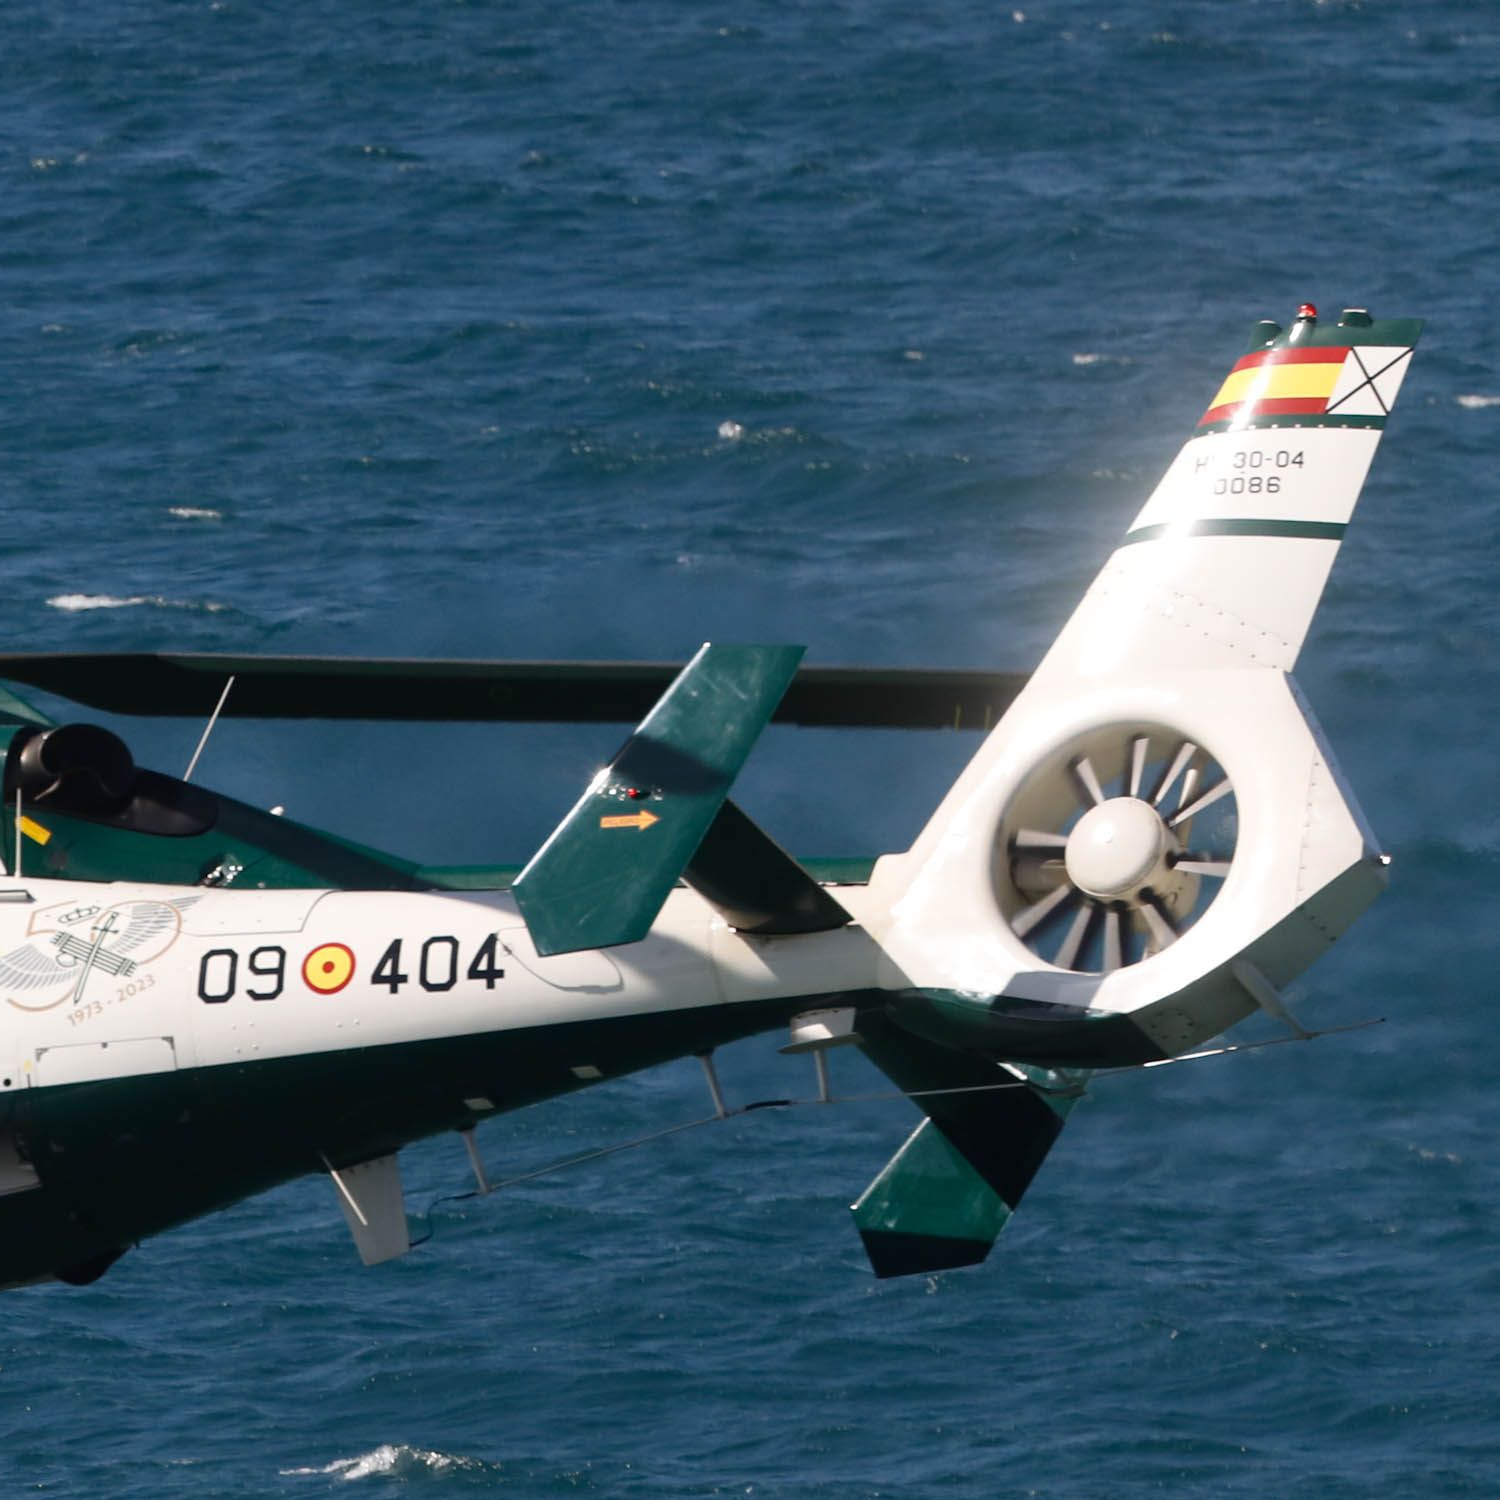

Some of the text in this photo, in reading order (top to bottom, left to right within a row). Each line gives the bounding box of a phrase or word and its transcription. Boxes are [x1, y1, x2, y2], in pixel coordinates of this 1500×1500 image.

[198, 934, 505, 1004] 09 404
[67, 1000, 103, 1028] 1973
[117, 973, 155, 1002] 2023
